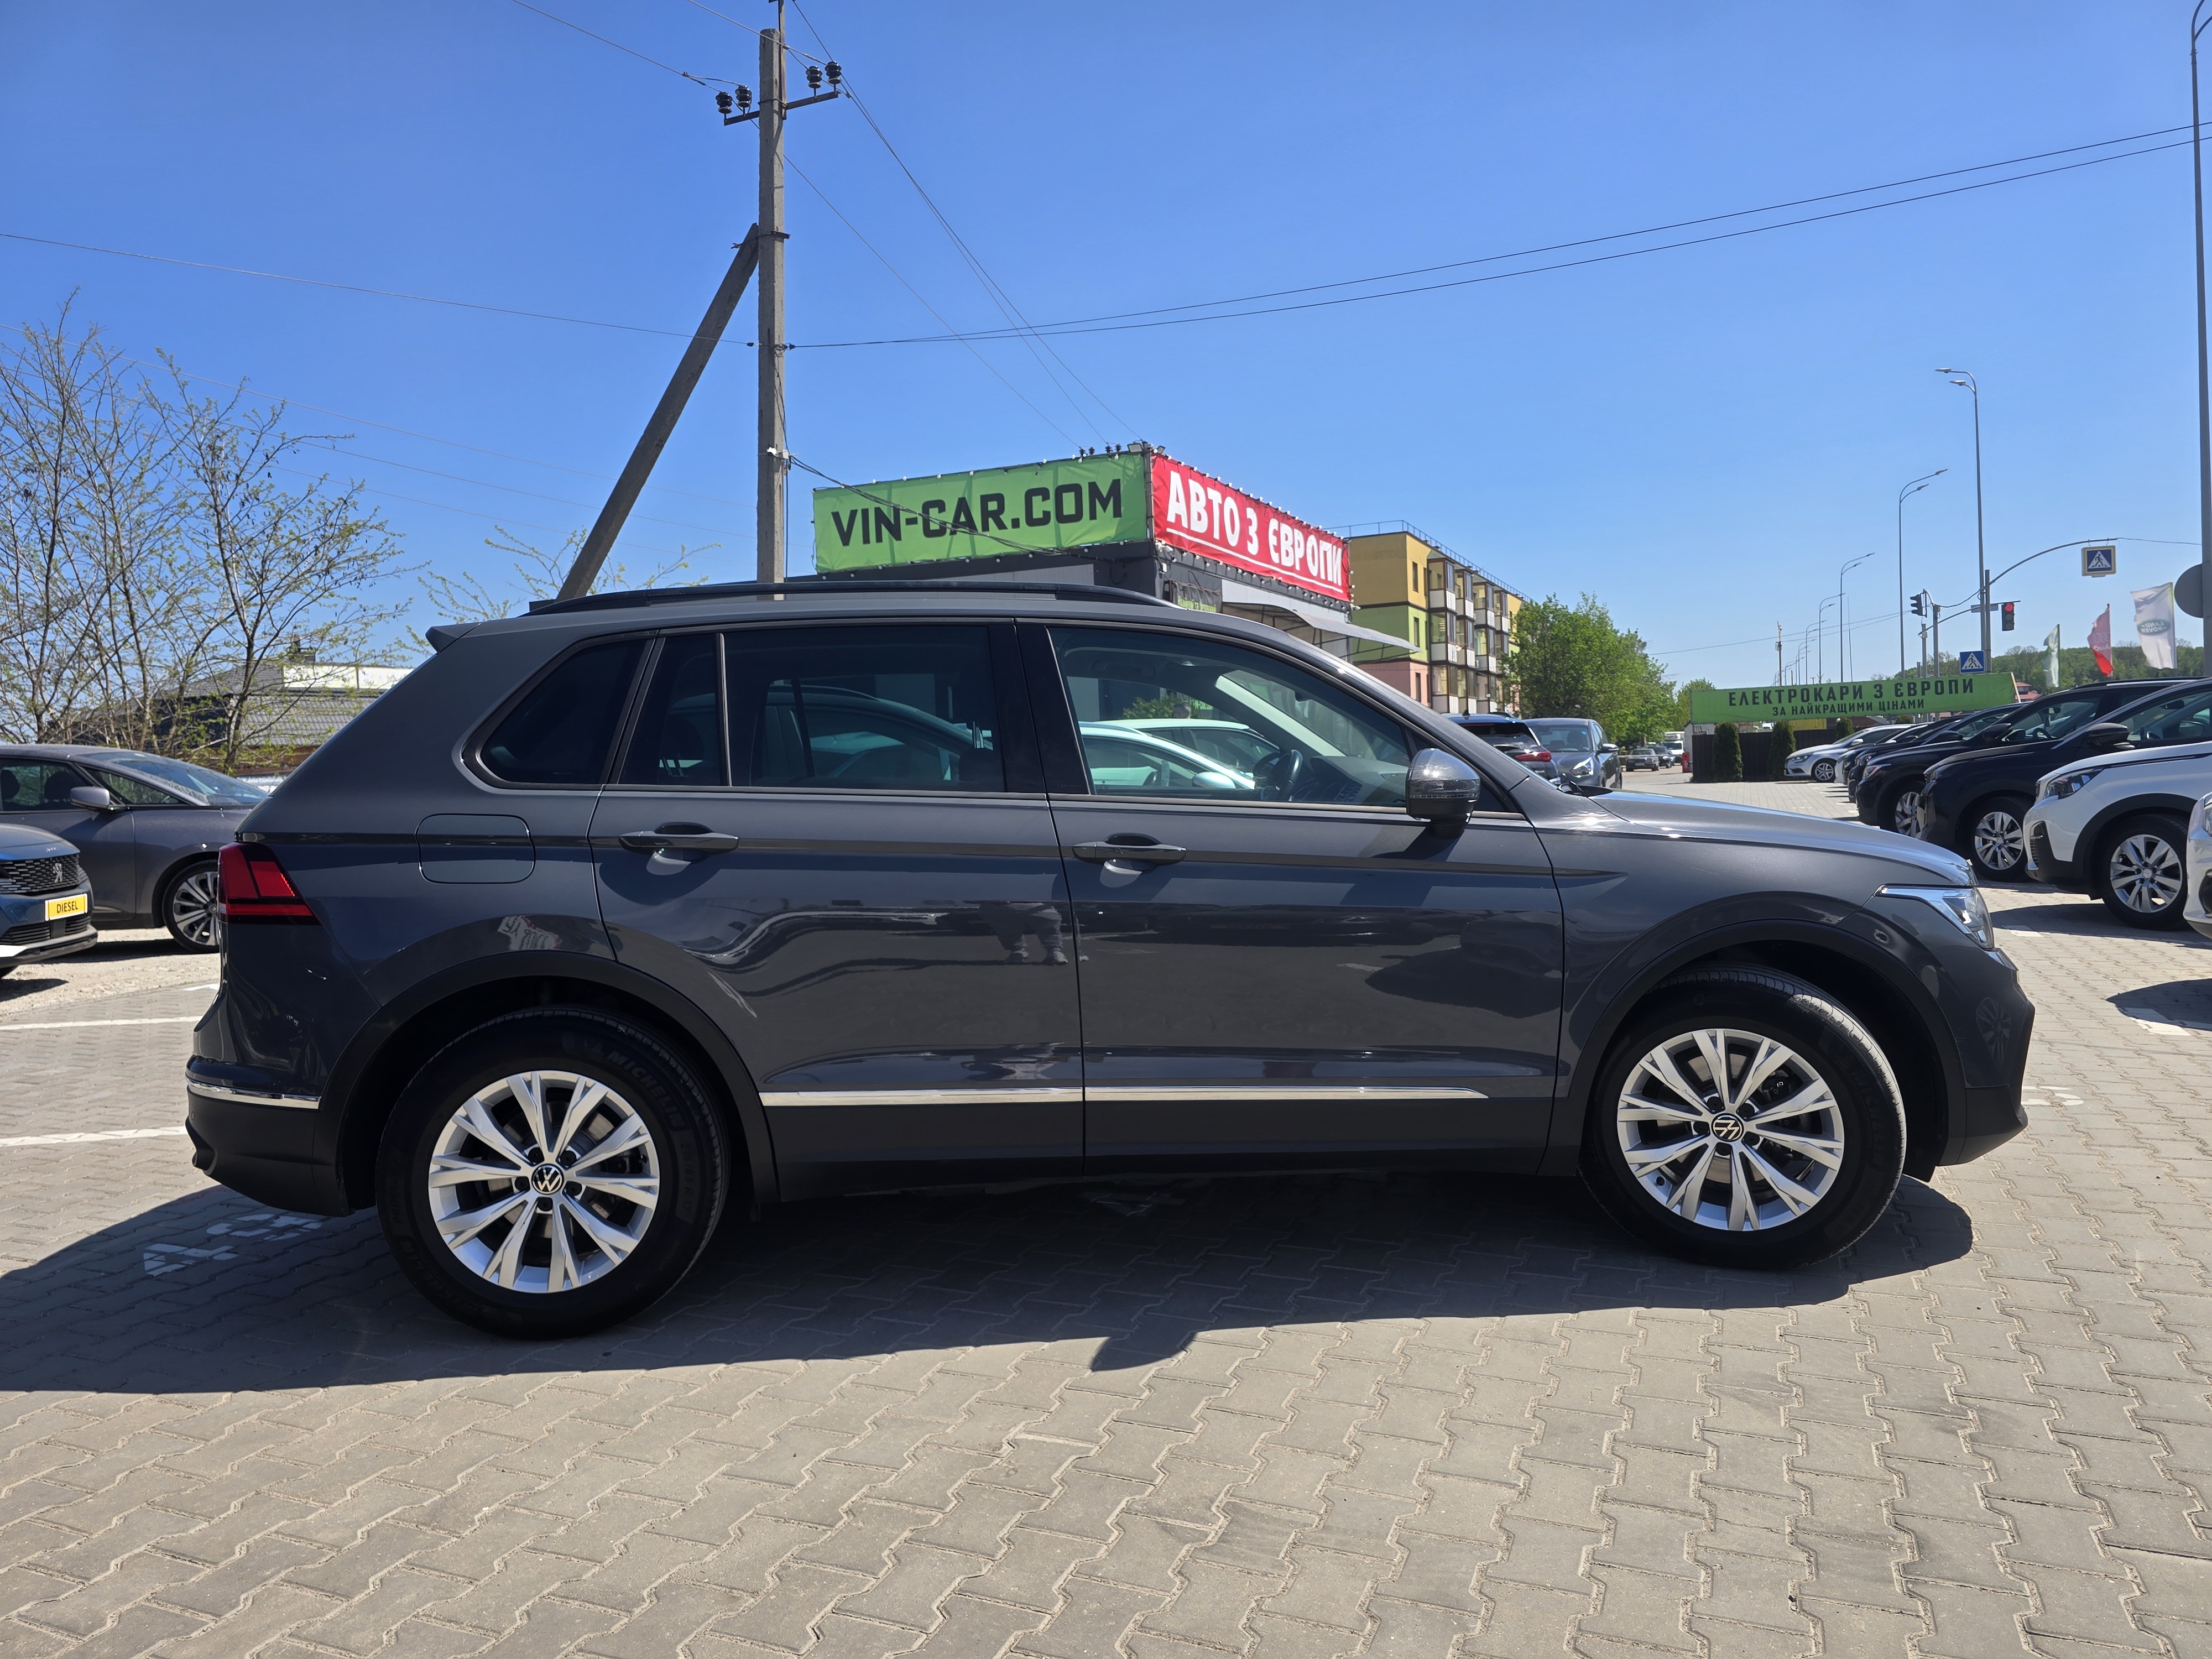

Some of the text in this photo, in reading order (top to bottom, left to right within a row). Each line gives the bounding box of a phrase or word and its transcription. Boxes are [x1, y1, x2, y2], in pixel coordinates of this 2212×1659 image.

[831, 479, 1121, 547] VIN-CAR.COM
[1167, 471, 1342, 586] АВТО З ЄВРОПИ
[1729, 678, 1974, 706] ЕЛЕКТРОКАРИ З ЄВРОПИ
[1772, 699, 1924, 716] ЗА НАЙКРАЩИМИ ЦІНАМИ
[57, 901, 79, 914] DIESEL
[606, 1050, 687, 1132] MICHELIN
